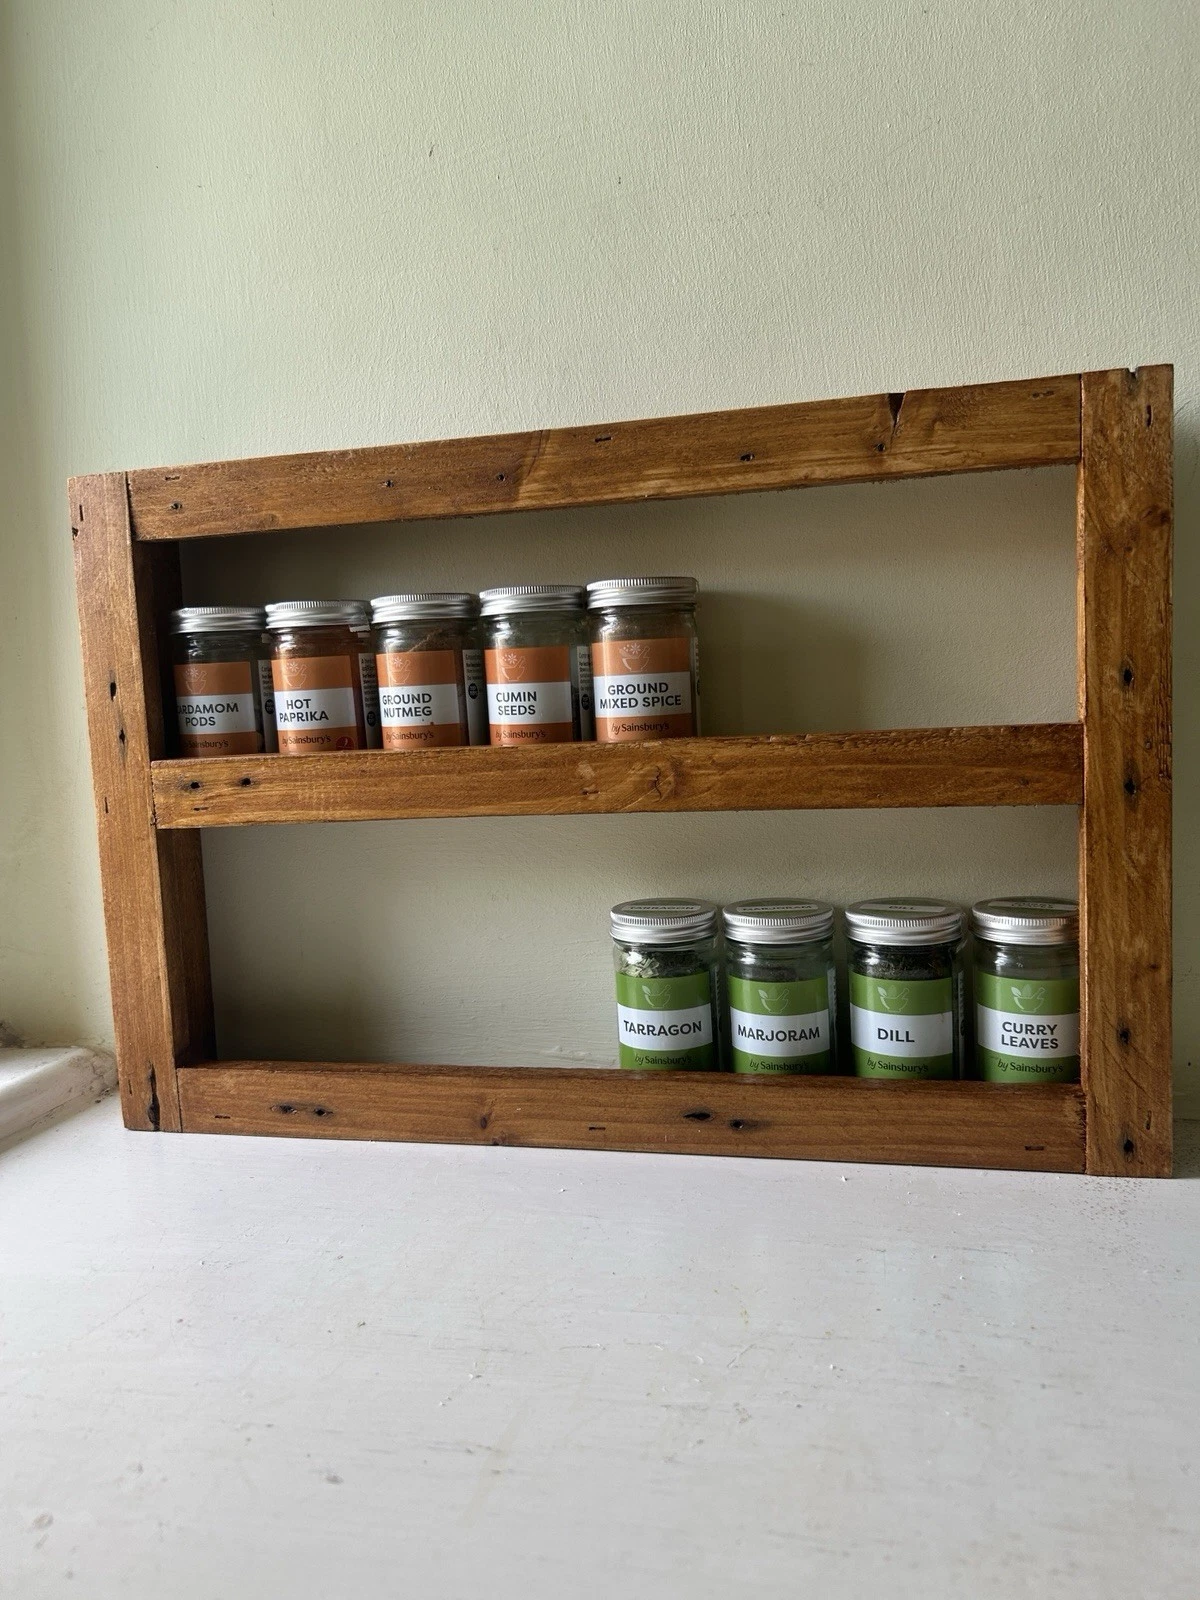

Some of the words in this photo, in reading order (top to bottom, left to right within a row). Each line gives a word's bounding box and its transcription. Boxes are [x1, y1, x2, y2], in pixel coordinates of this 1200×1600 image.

[607, 682, 669, 695] GROUND
[382, 693, 432, 705] GROUND
[496, 691, 537, 703] CUMIN
[600, 697, 639, 709] MIXED
[643, 694, 682, 707] SPICE
[286, 698, 311, 710] HOT
[498, 704, 536, 716] SEEDS
[279, 710, 329, 723] PAPRIKA
[383, 706, 432, 718] NUTMEG
[185, 716, 216, 727] PODS
[503, 729, 546, 740] Sainsbury's
[611, 724, 621, 735] by
[622, 722, 670, 734] Sainsbury's
[288, 734, 331, 745] Sainsbury's
[392, 730, 434, 741] Sainsbury's
[623, 1020, 702, 1037] TARRAGON
[738, 1024, 820, 1042] MARJORAM
[1002, 1021, 1058, 1036] CURRY
[877, 1028, 915, 1043] DILL
[1001, 1034, 1058, 1049] LEAVES
[634, 1054, 644, 1065] by
[645, 1054, 692, 1066] Sainsbury's
[749, 1060, 759, 1071] by
[760, 1061, 809, 1072] Sainsbury's
[867, 1056, 877, 1069] by
[877, 1060, 929, 1074] Sainsbury's
[997, 1058, 1009, 1071] by
[1010, 1061, 1063, 1074] Sainsbury's
